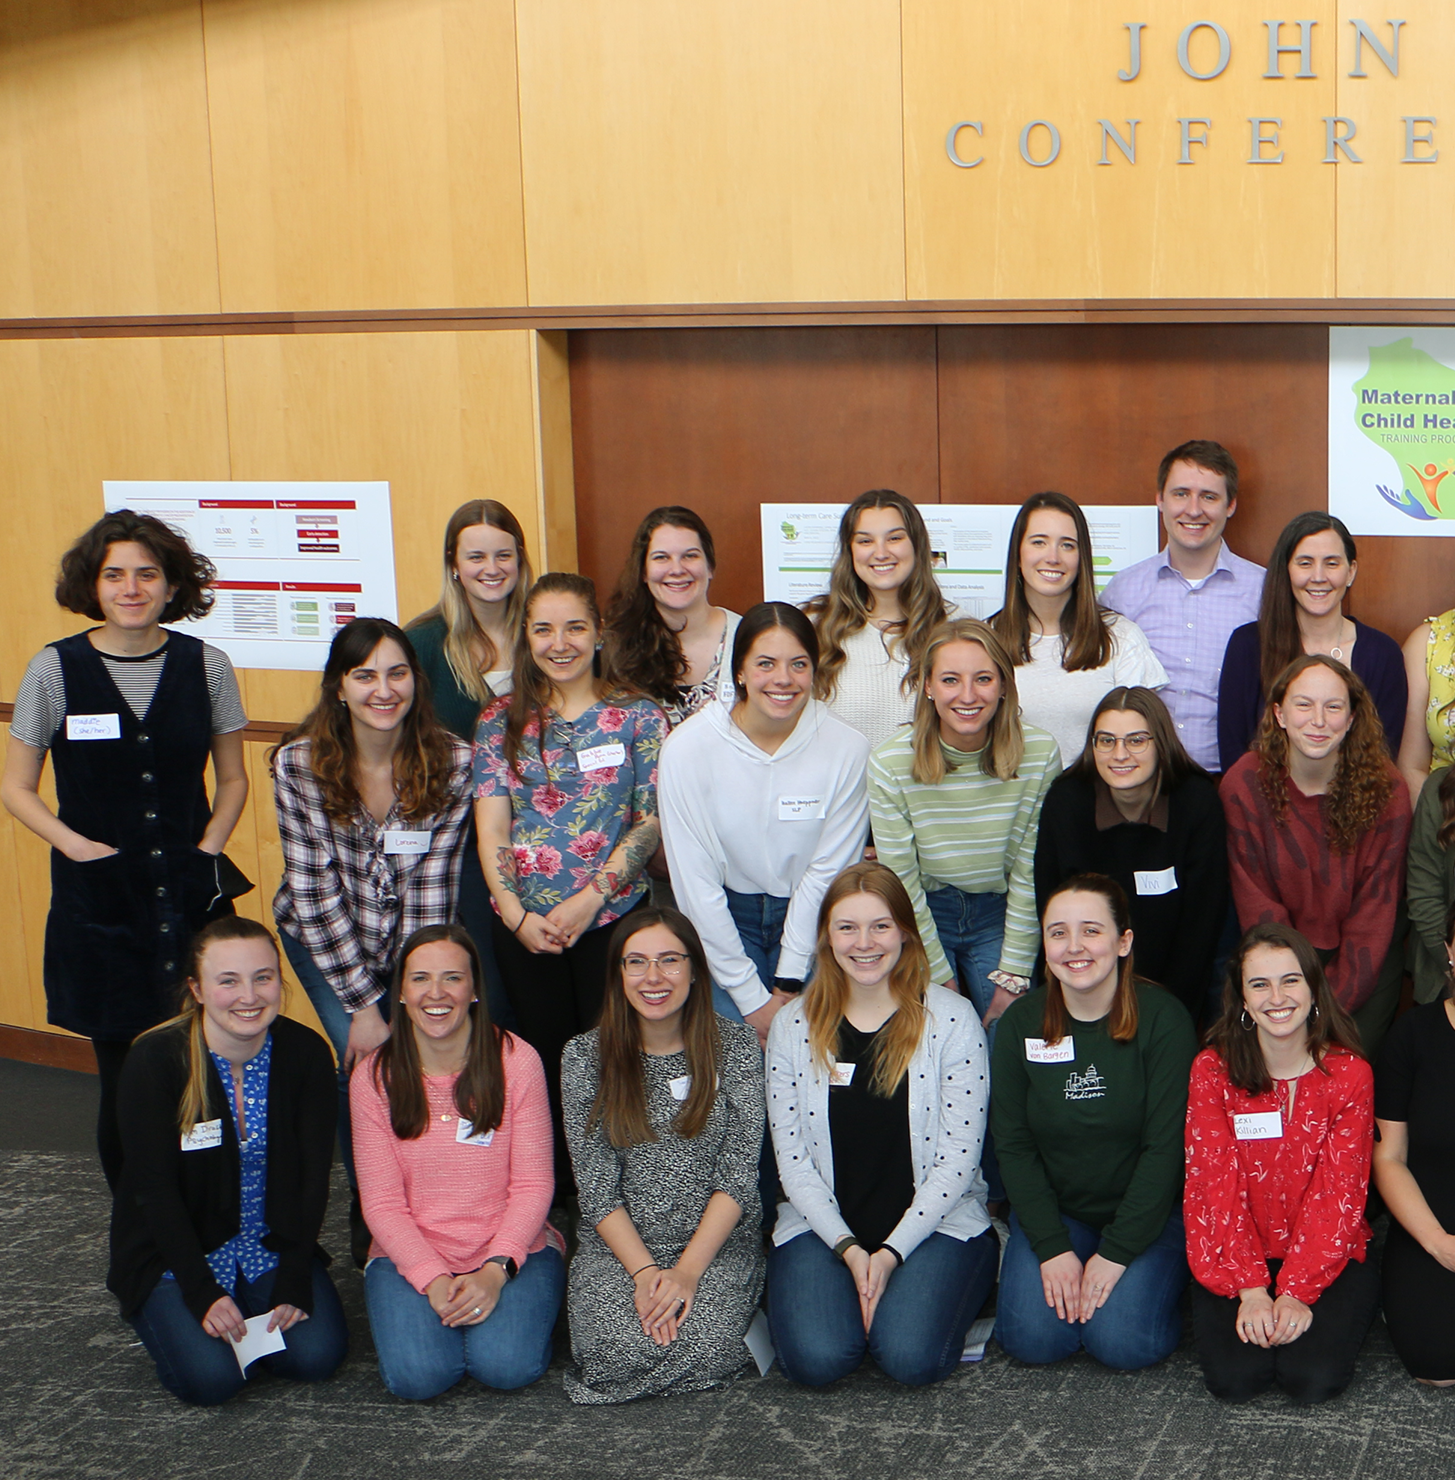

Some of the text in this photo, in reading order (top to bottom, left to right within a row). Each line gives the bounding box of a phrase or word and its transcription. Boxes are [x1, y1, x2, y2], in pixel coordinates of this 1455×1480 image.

[1117, 19, 1406, 81] JOHN
[1361, 412, 1415, 429] Child
[1380, 433, 1428, 443] TRAINING
[1141, 875, 1160, 889] Vivi
[1065, 1091, 1105, 1100] Madison
[1236, 1126, 1267, 1135] Killian
